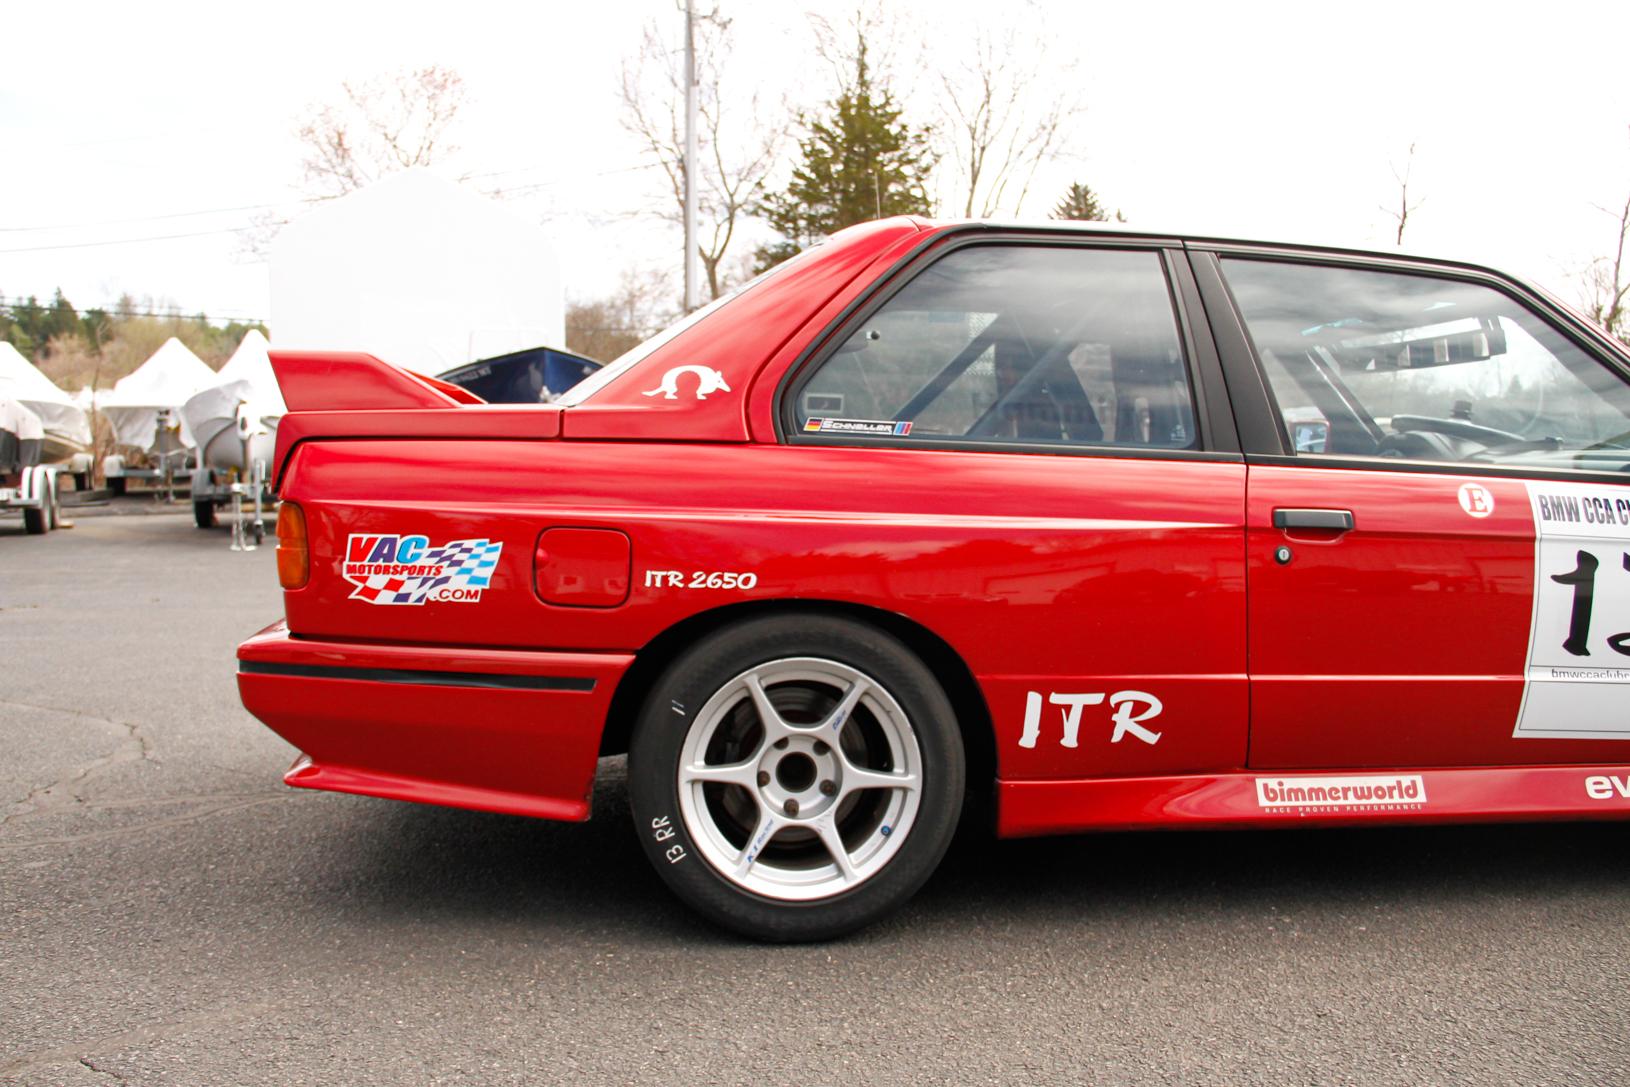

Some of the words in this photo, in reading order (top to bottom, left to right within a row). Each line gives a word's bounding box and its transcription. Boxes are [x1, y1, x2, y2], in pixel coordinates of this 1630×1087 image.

[1464, 487, 1489, 512] E
[1538, 494, 1581, 523] BMW
[1582, 496, 1616, 525] CCA
[350, 537, 427, 563] VAC
[345, 564, 443, 576] MOTORSPORTS
[644, 570, 684, 588] ITR
[687, 571, 757, 590] 2650
[433, 588, 480, 600] .COM
[1018, 690, 1163, 749] ITR
[1262, 779, 1419, 803] bimmerworld
[1265, 806, 1292, 814] RACE
[1298, 804, 1340, 813] PROVEN
[1346, 803, 1422, 812] PERFORMANCE
[652, 815, 676, 842] RR
